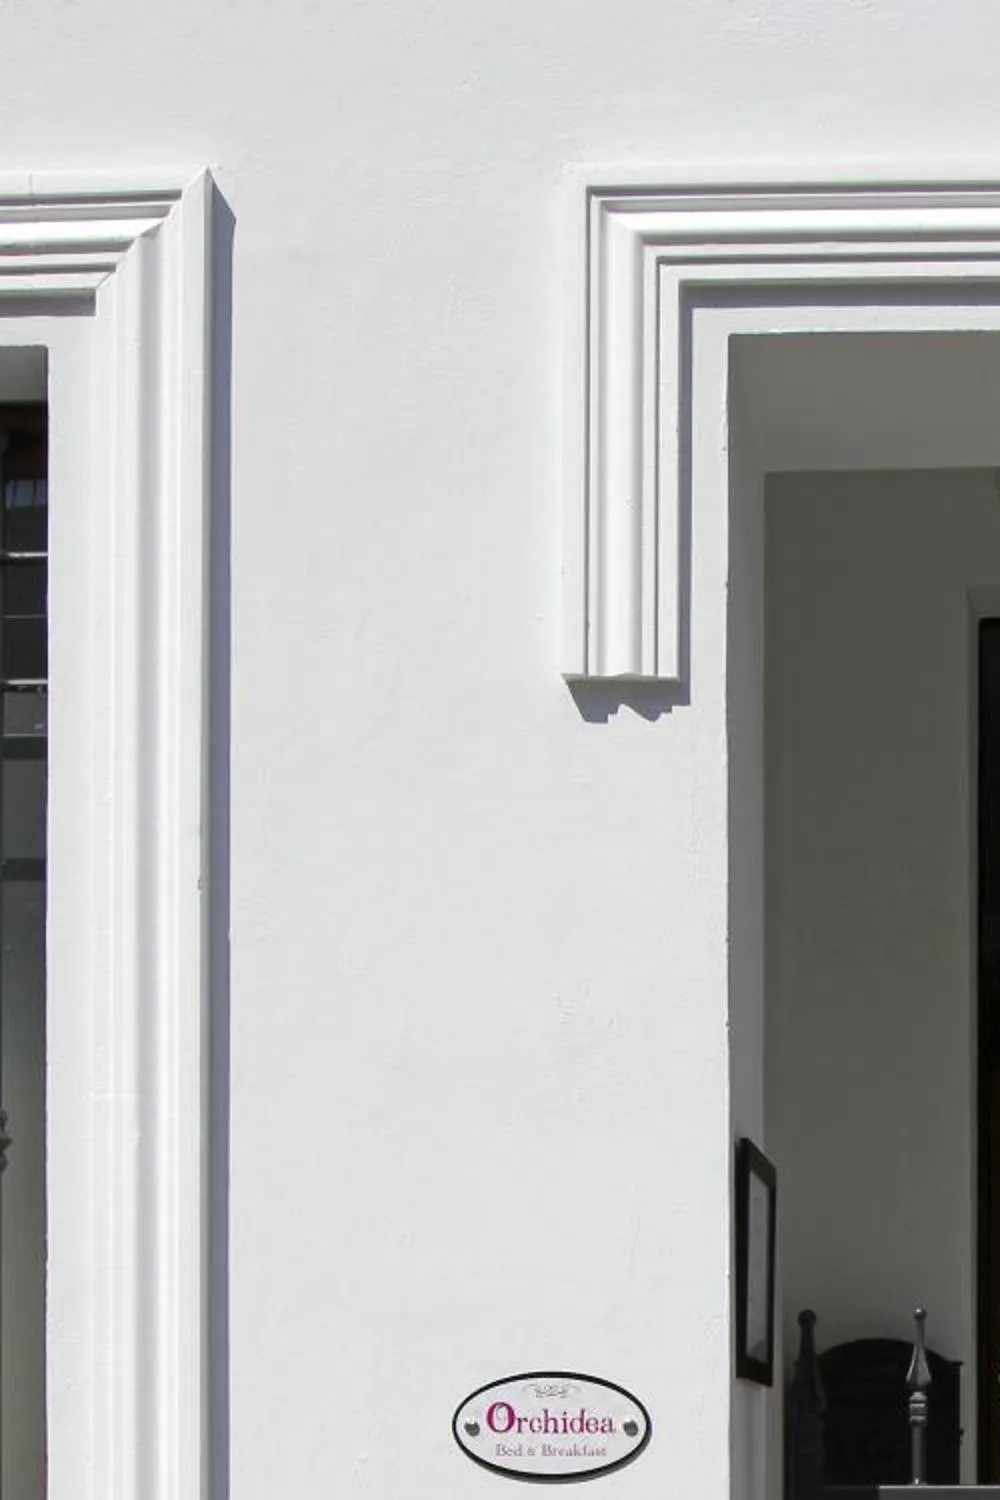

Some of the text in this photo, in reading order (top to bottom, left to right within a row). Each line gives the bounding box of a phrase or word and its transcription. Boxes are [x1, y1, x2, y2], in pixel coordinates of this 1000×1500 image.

[486, 1401, 616, 1434] Orchidea
[495, 1443, 522, 1457] Bed
[541, 1443, 607, 1457] Breakfast
